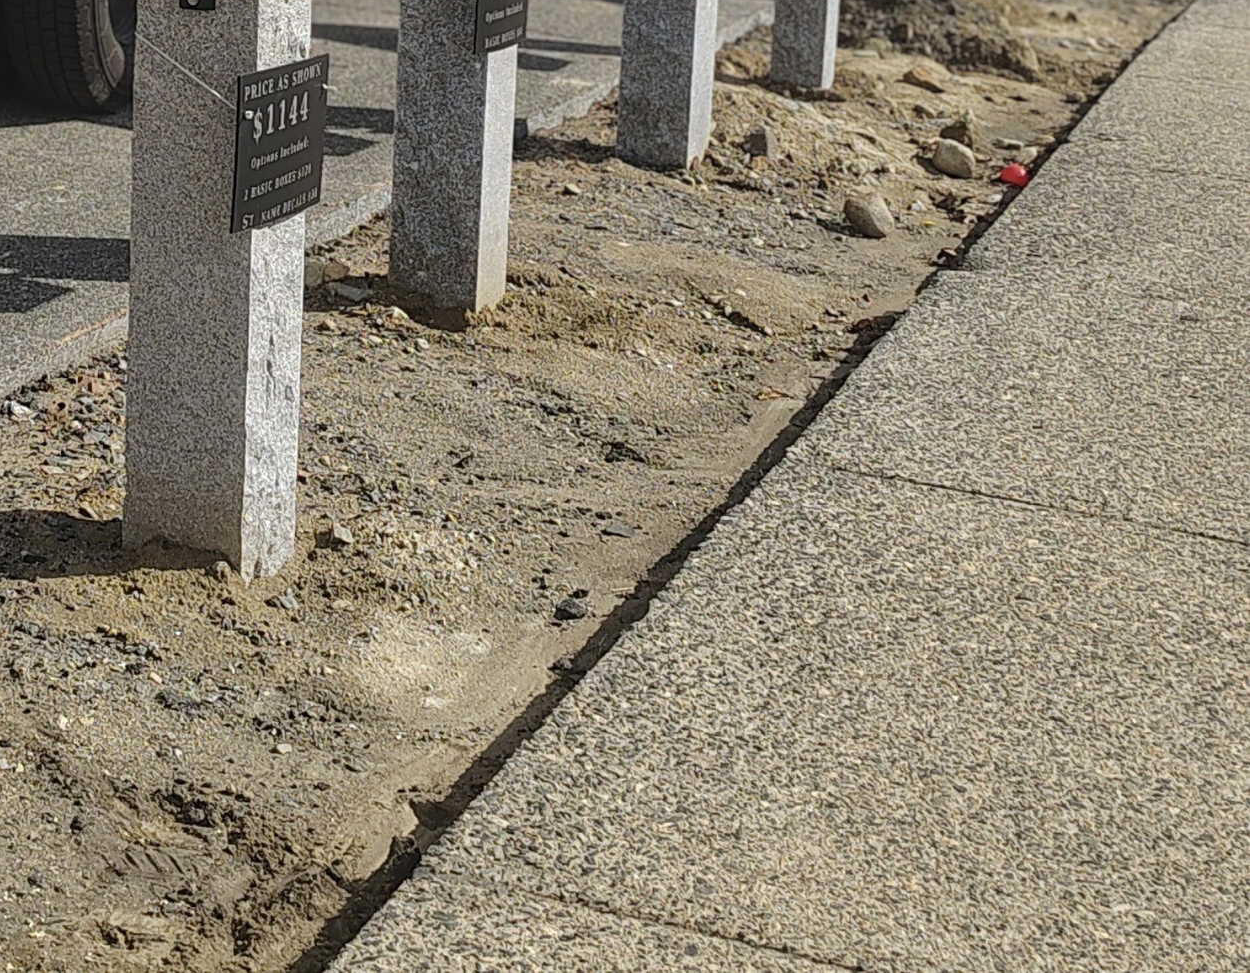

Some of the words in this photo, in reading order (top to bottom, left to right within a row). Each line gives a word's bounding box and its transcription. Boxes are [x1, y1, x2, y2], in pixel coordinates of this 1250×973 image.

[244, 78, 275, 103] PRICE
[276, 74, 290, 92] AS
[292, 62, 323, 87] SHOWN
[253, 91, 309, 145] $1144
[251, 151, 279, 170] Options
[251, 179, 273, 199] BASIC
